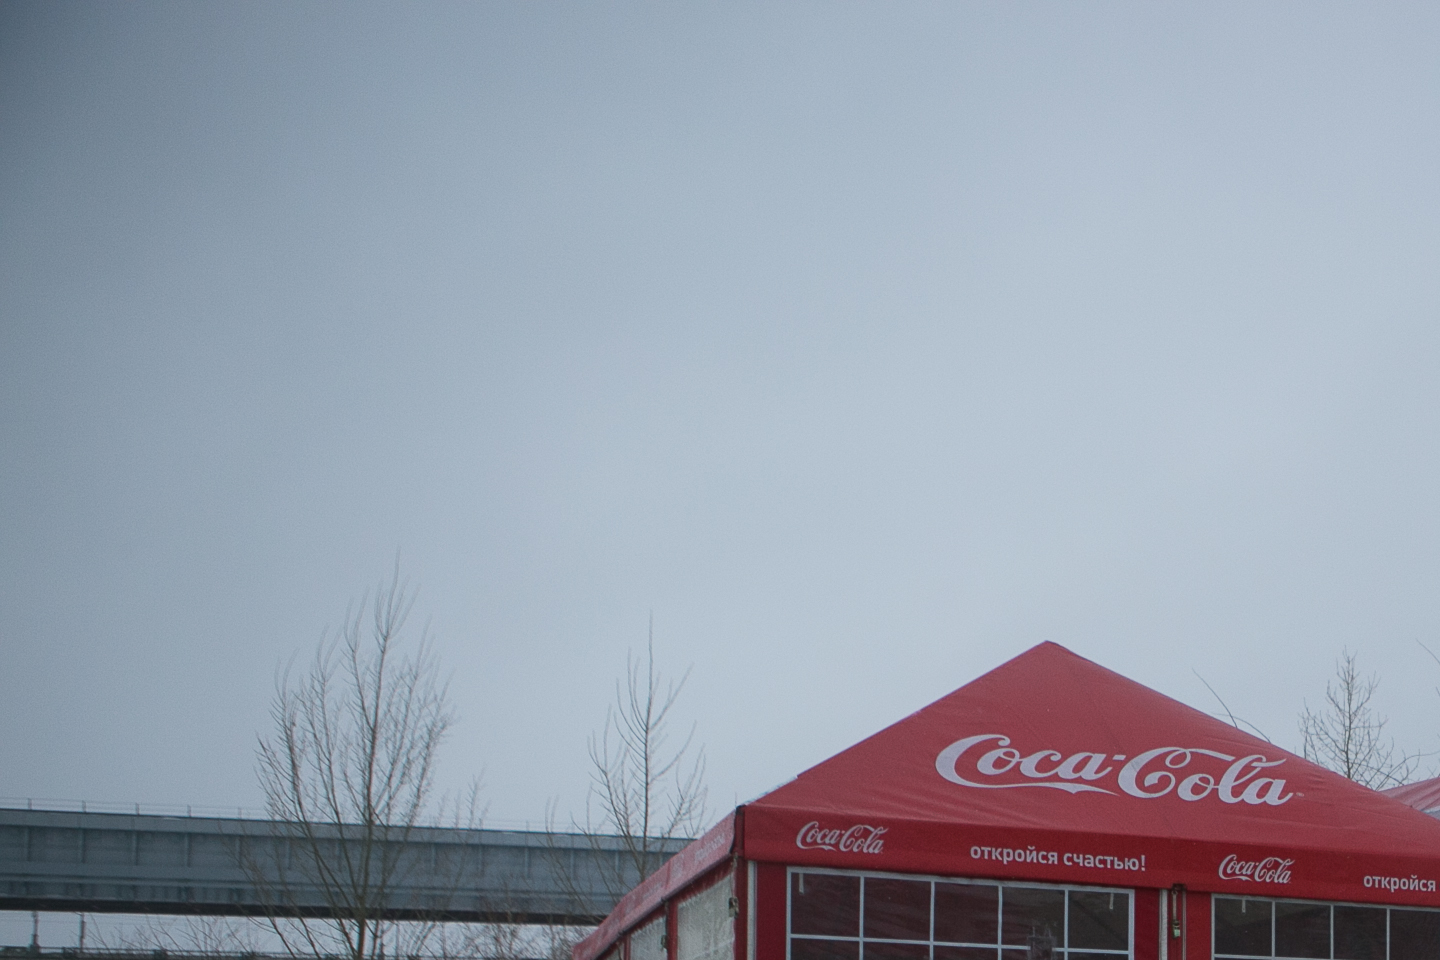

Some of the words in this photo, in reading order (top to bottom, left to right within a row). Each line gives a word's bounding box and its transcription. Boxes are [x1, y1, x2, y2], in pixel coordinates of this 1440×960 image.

[936, 734, 1294, 805] Coca-Cola
[796, 821, 885, 853] Coca-Cola
[971, 846, 1058, 864] откройся
[1064, 853, 1146, 871] счастью!
[1219, 854, 1292, 883] Coca-Cola
[1364, 875, 1436, 892] откройся
